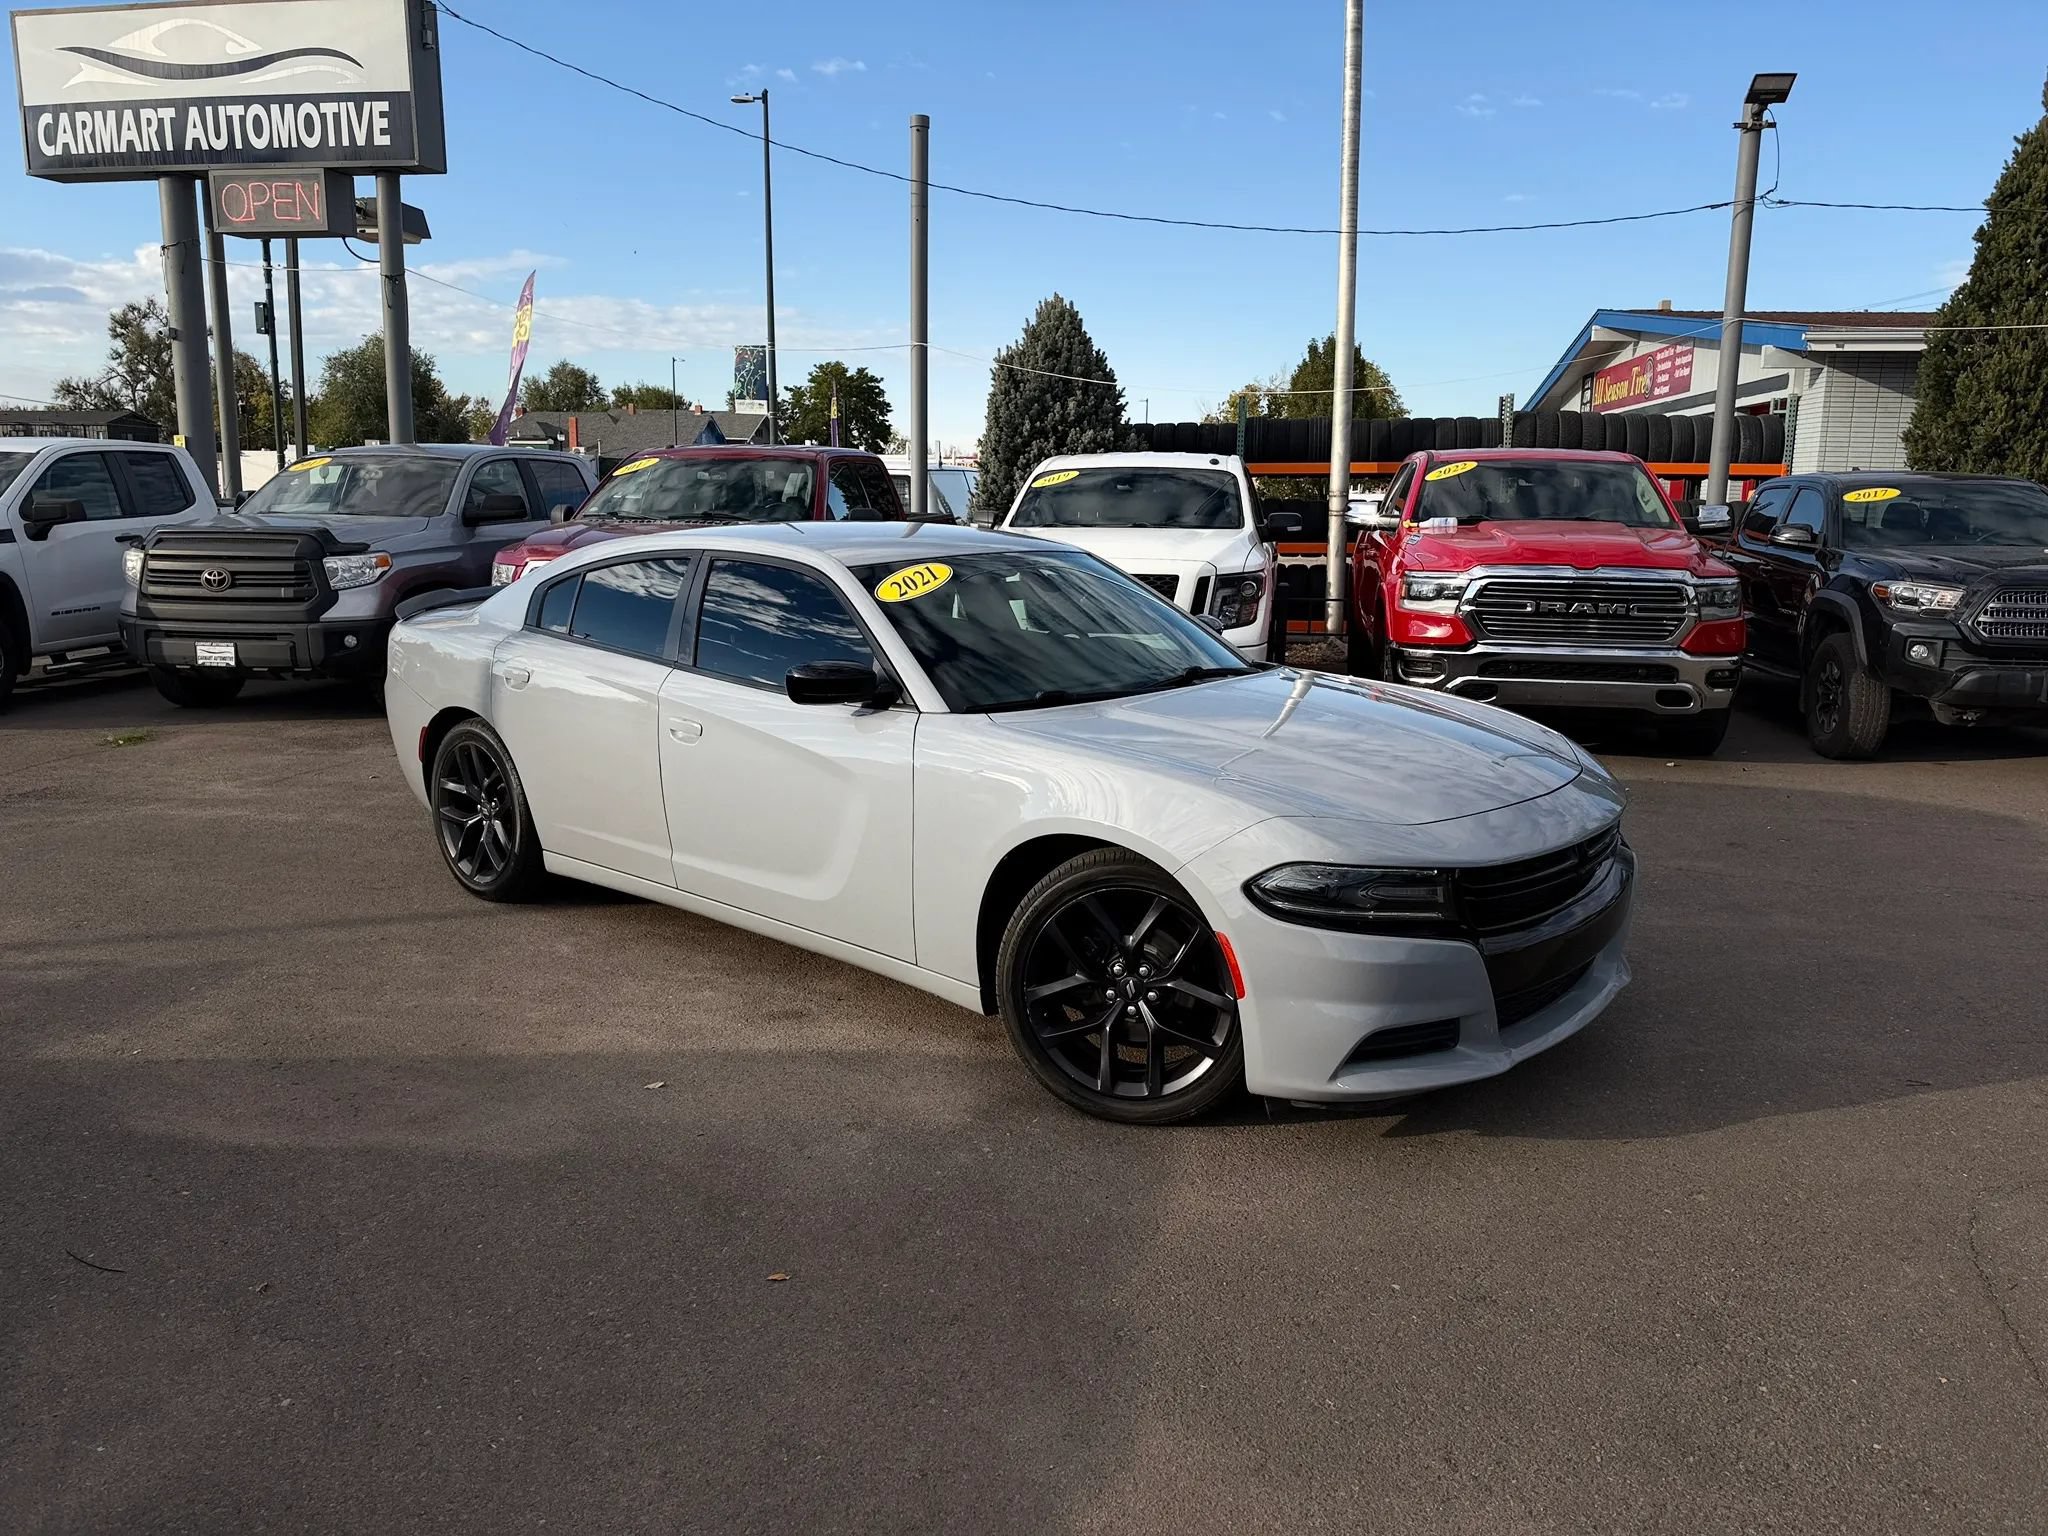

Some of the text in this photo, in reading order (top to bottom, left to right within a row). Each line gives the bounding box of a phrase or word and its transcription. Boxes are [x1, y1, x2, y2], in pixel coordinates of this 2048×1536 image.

[36, 101, 391, 157] CARMART AUTOMOTIVE
[221, 182, 320, 221] OPEN
[1604, 375, 1628, 404] Season
[1435, 462, 1468, 478] 2022
[1854, 489, 1889, 501] 2017
[890, 566, 939, 597] 2021
[1539, 601, 1627, 614] RAM
